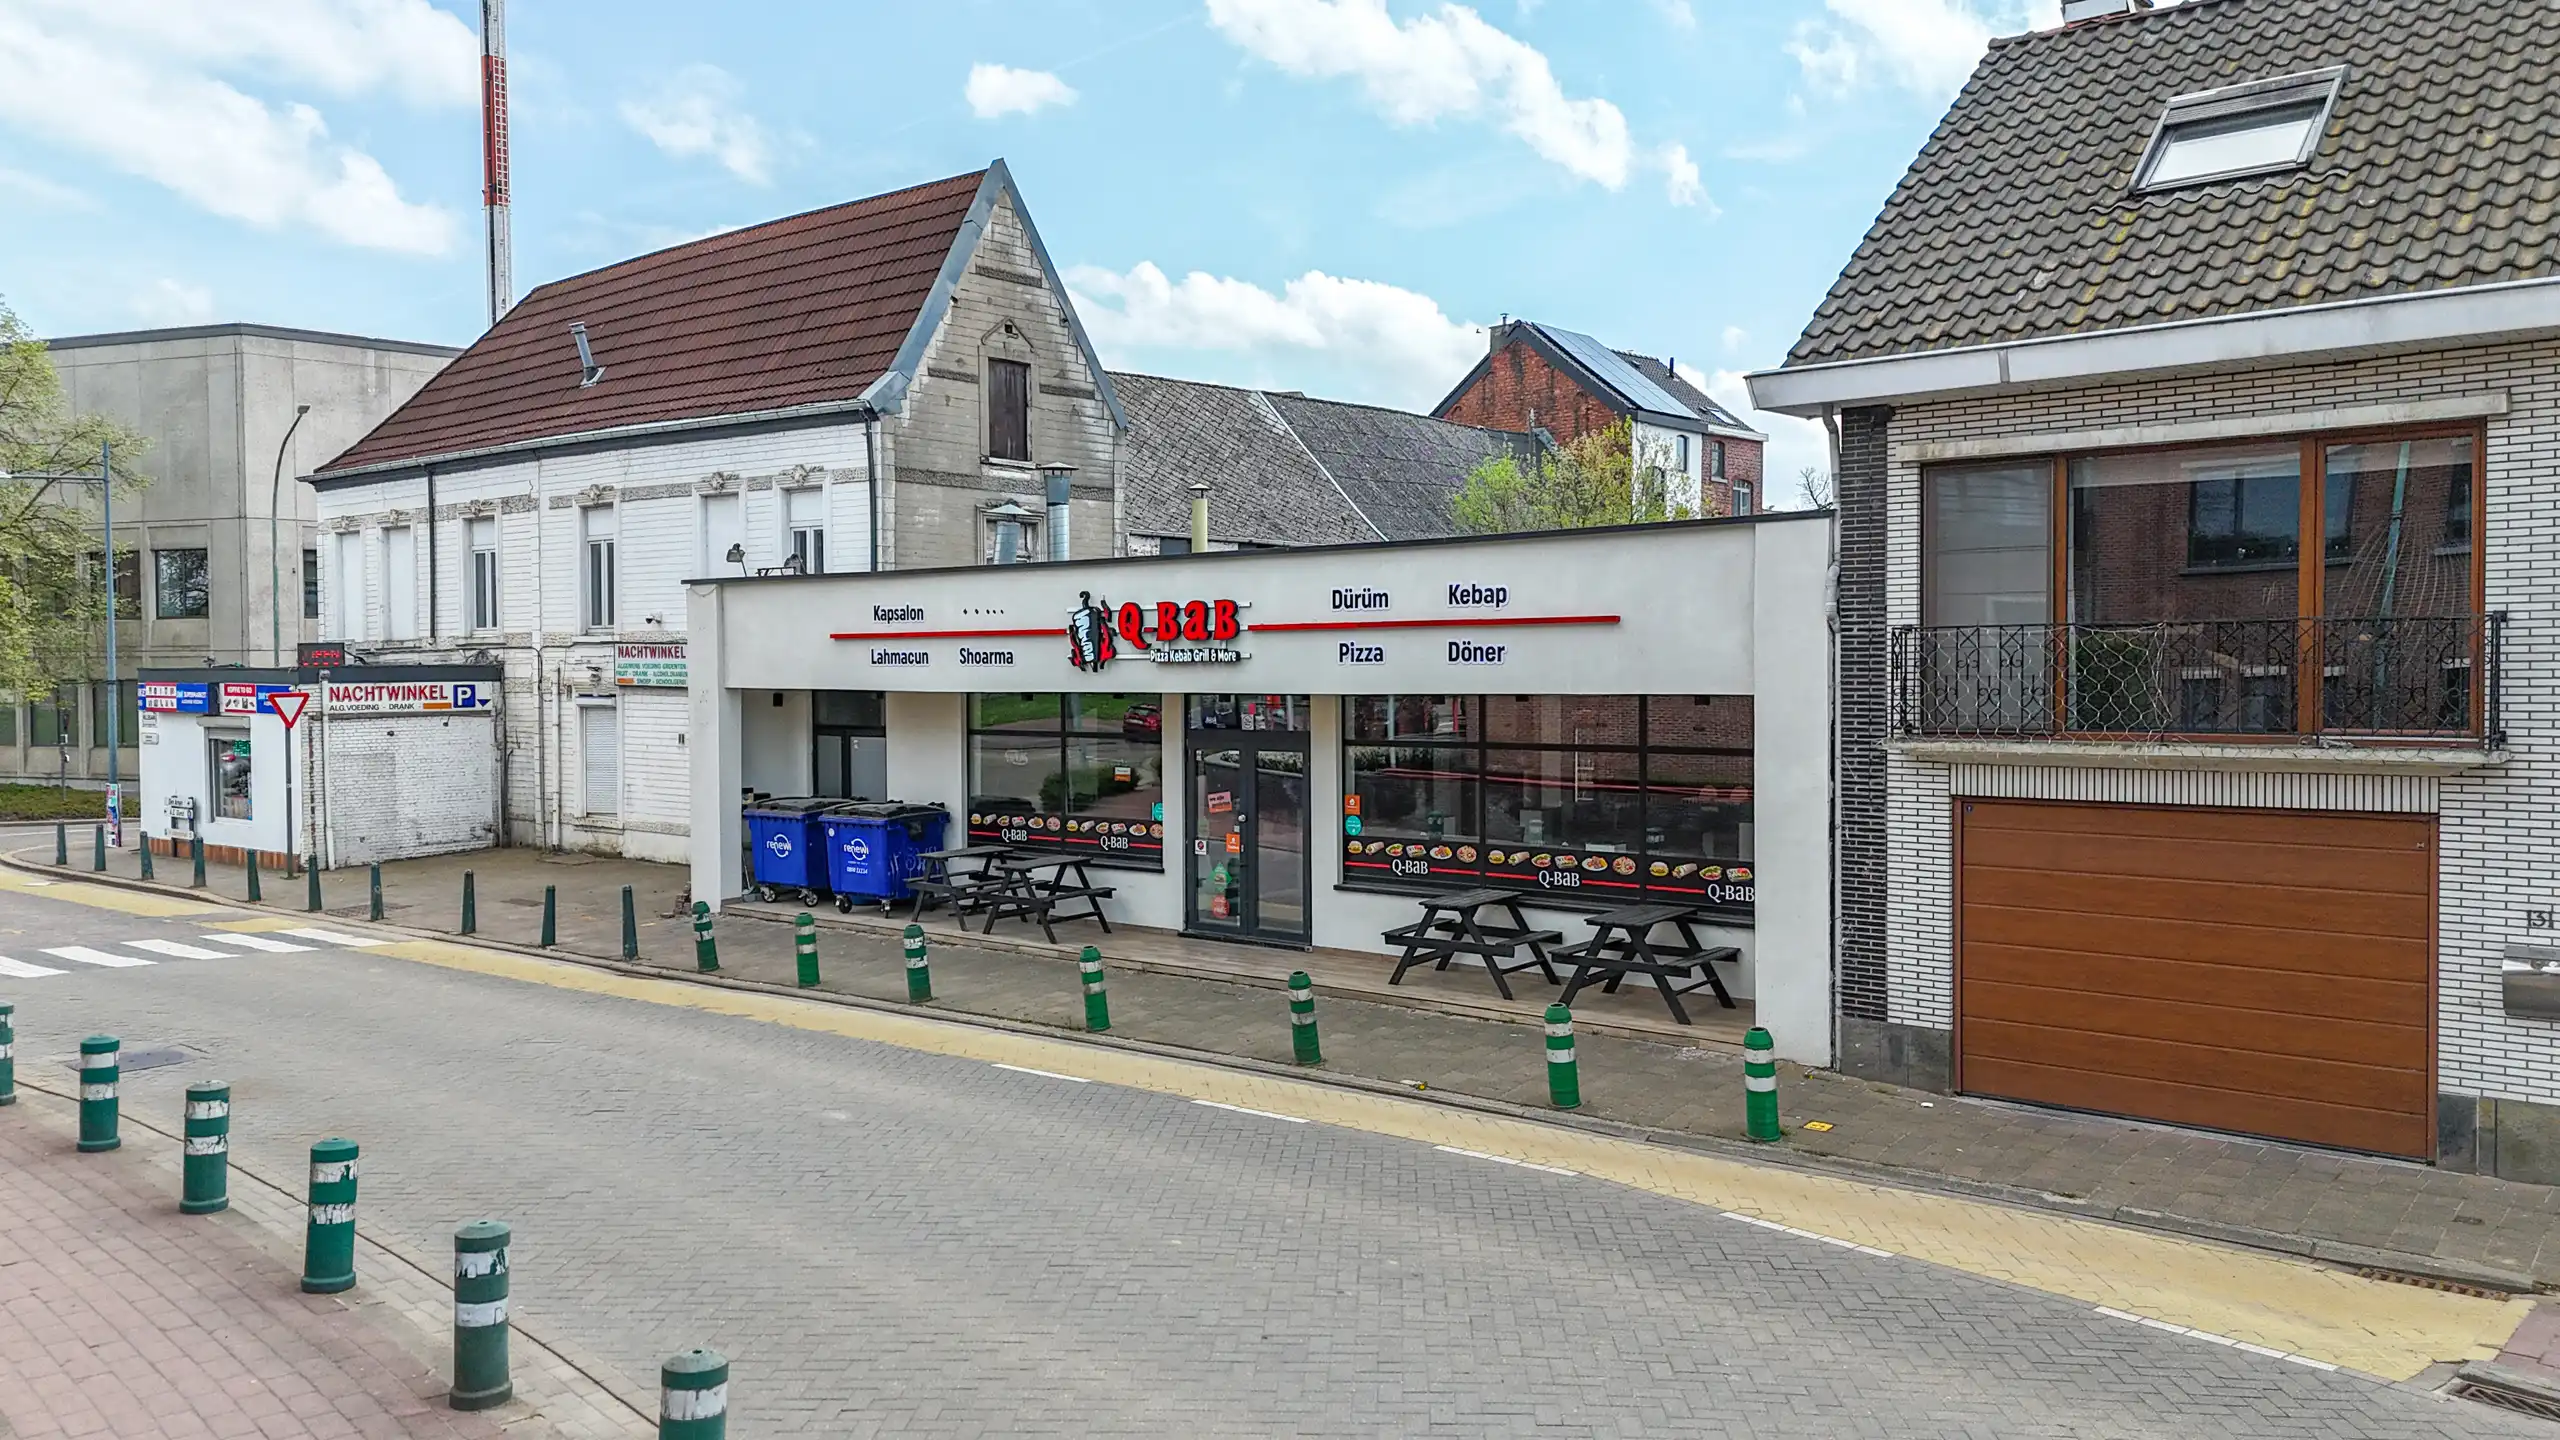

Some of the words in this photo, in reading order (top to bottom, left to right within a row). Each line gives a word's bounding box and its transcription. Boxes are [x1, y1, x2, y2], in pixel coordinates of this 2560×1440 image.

[1332, 588, 1389, 609] Dürüm
[1448, 584, 1507, 608] Kebap
[873, 604, 924, 624] Kapsalon
[617, 645, 687, 659] NACHTWINKEL
[870, 648, 929, 665] Lahmacun
[959, 647, 1014, 665] Shoarma
[1150, 649, 1169, 662] Pizza
[1169, 649, 1192, 662] Kebab
[1193, 648, 1210, 662] Grill
[1210, 649, 1216, 662] &
[1217, 649, 1237, 662] More
[1338, 642, 1384, 663] Pizza
[1448, 641, 1505, 662] Döner
[328, 684, 448, 703] NACHTWINKEL
[457, 686, 472, 706] P
